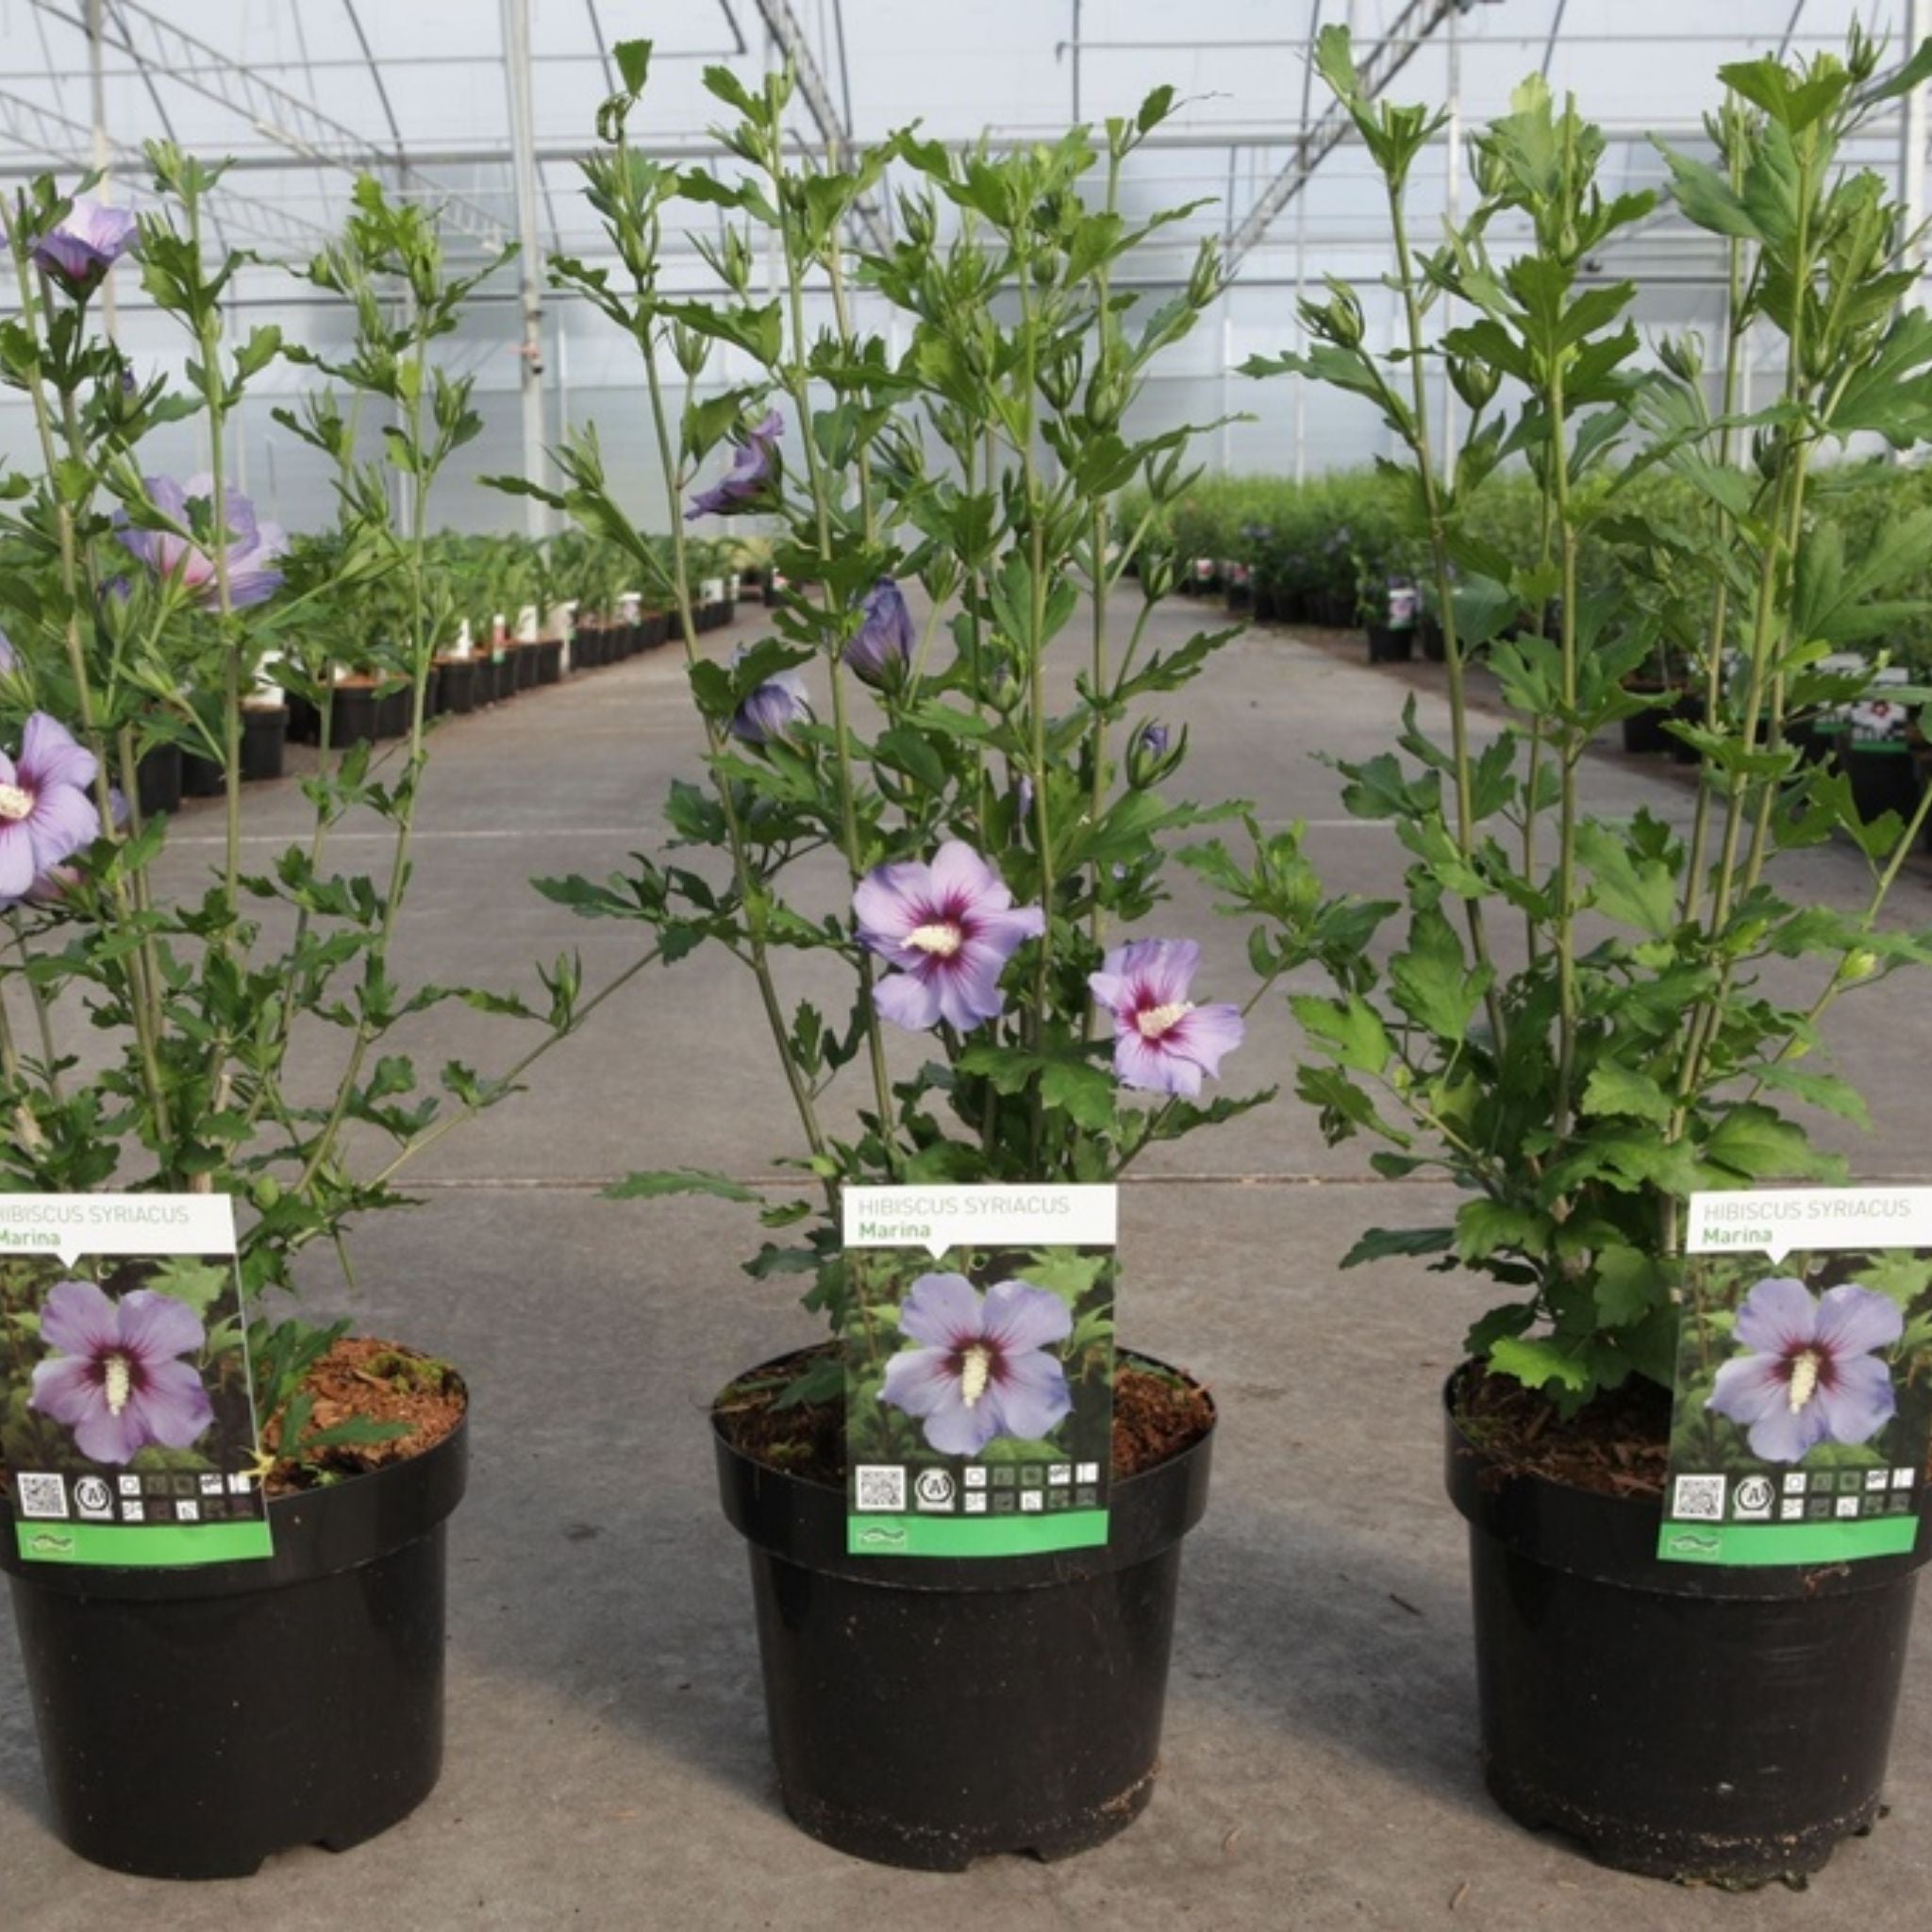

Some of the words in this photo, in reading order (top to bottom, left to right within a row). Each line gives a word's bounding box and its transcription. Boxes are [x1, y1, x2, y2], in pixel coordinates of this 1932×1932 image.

[88, 1205, 191, 1224] SYRIACUS
[858, 1196, 958, 1216] HIBISCUS
[964, 1195, 1071, 1215] SYRIACUS
[1703, 1201, 1802, 1222] HIBISCUS
[1807, 1198, 1912, 1219] SYRIACUS
[858, 1221, 932, 1239] Marina
[1702, 1226, 1774, 1245] Marina
